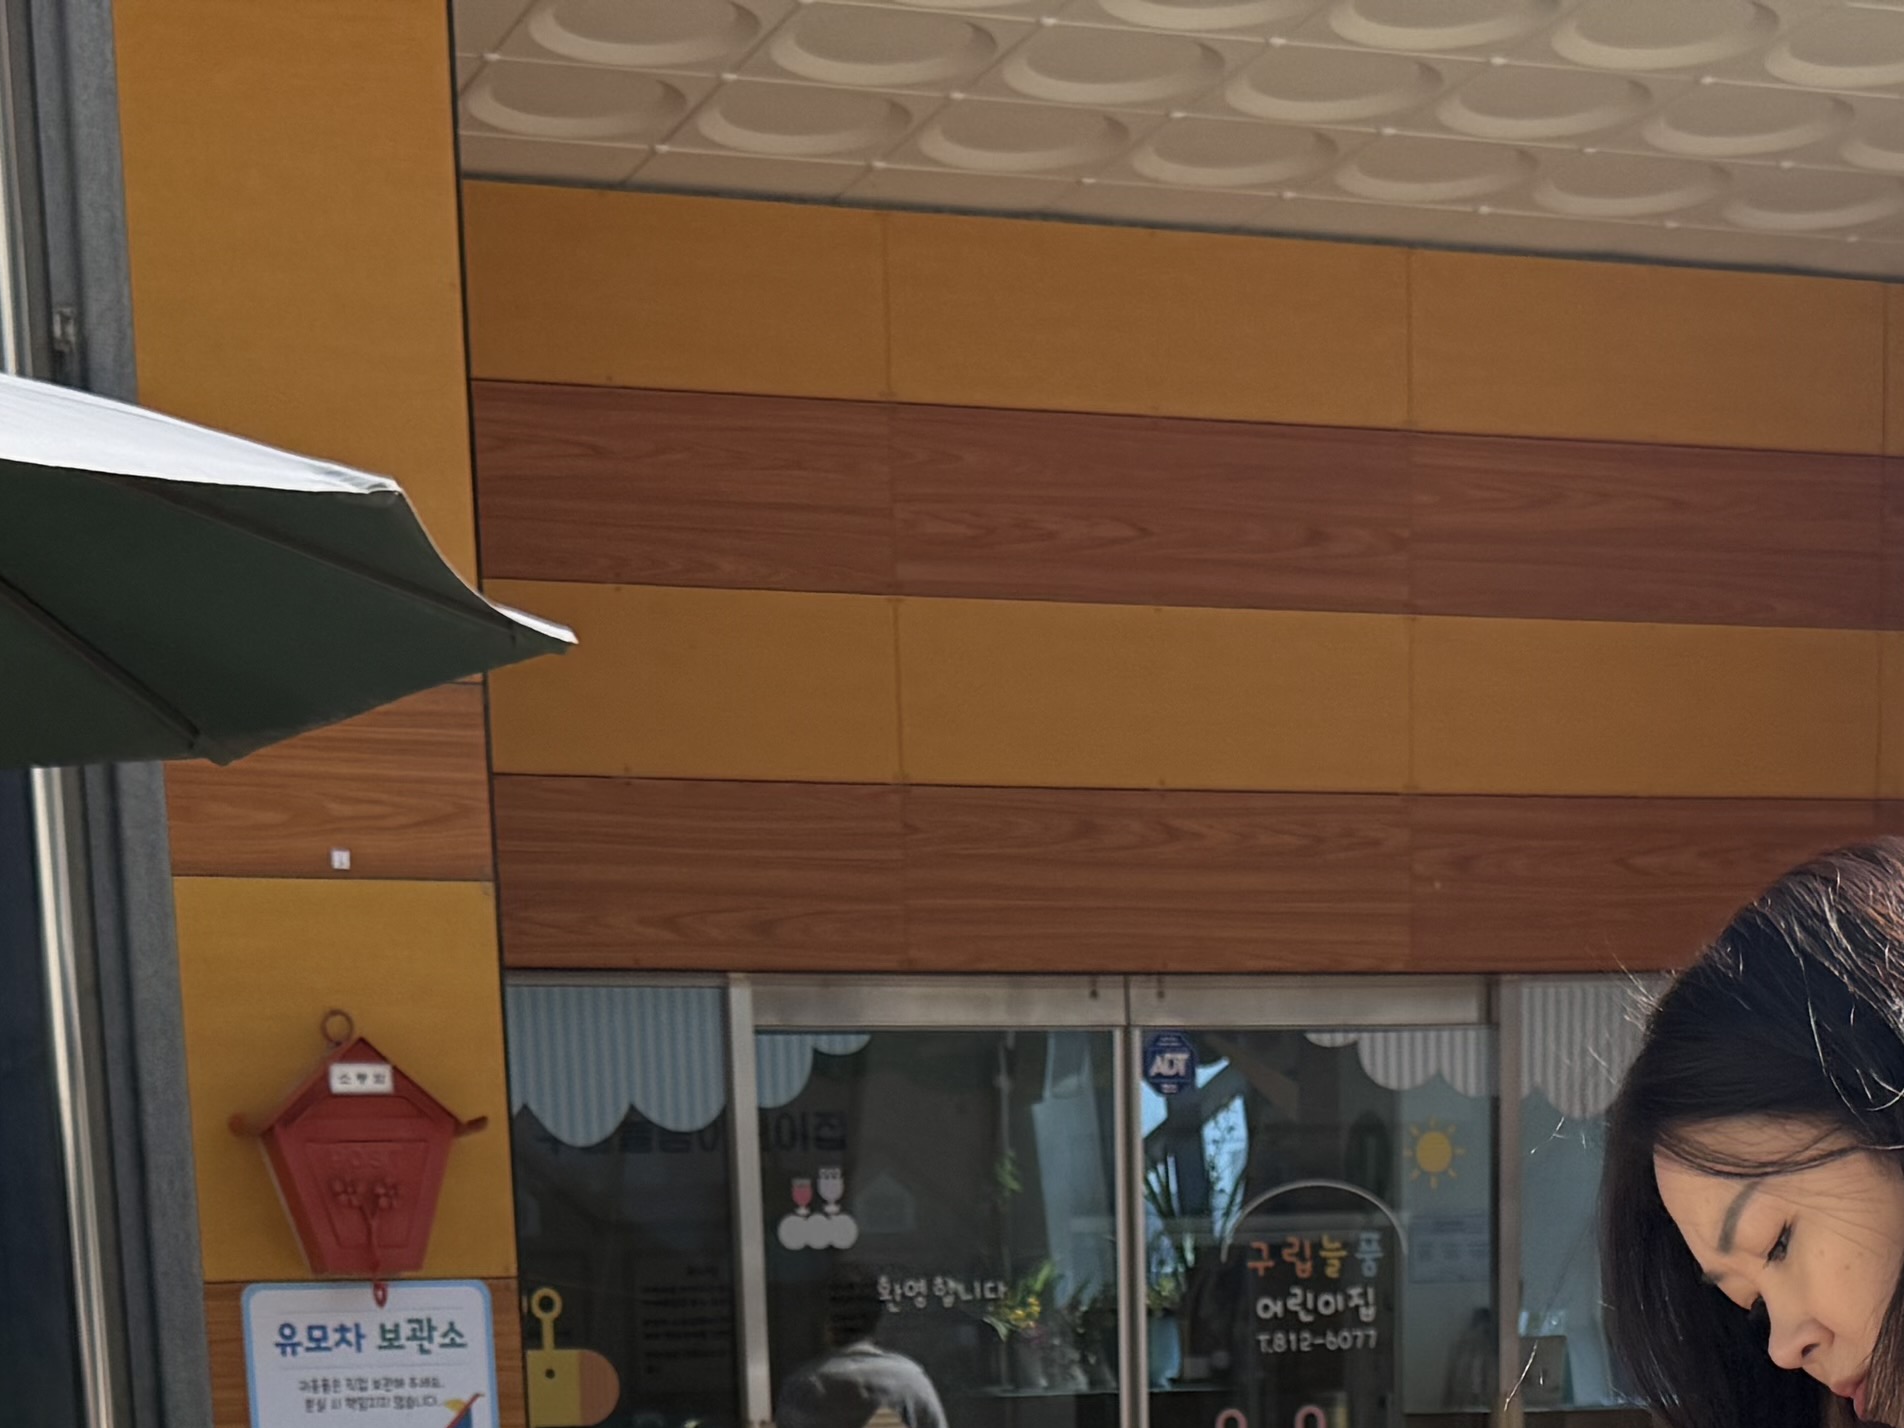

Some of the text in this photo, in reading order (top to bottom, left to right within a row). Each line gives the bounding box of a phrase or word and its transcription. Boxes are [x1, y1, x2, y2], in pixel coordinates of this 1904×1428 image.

[1149, 1053, 1191, 1077] ADT
[1256, 1285, 1377, 1322] 어린이집
[274, 1317, 468, 1357] 유모차 보관소
